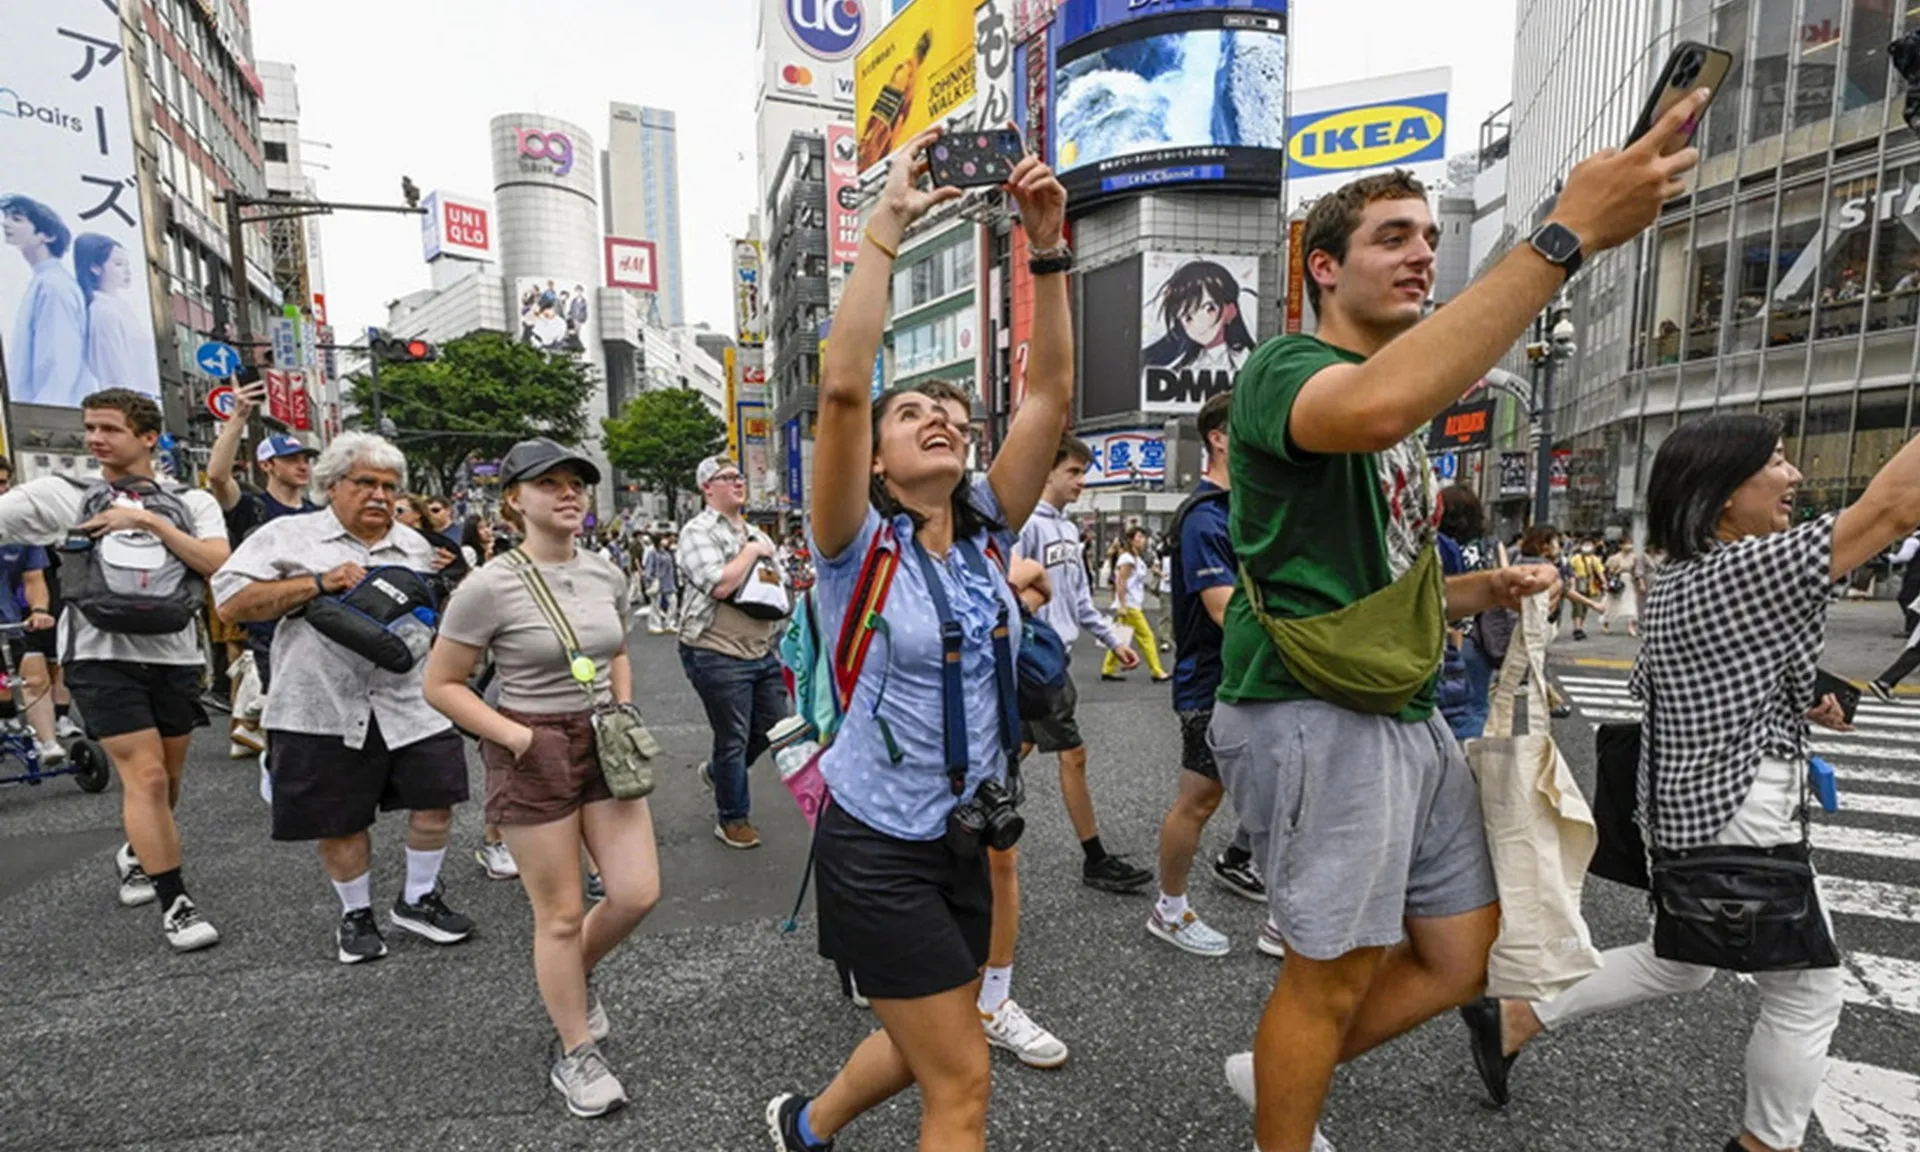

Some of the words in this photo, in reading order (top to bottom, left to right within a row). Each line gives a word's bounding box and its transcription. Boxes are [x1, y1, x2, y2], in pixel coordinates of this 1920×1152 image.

[57, 0, 138, 227] アーズ
[927, 77, 975, 118] WALKE
[16, 100, 83, 133] pairs
[511, 126, 573, 176] 109
[1300, 116, 1431, 157] IKEA
[448, 209, 481, 228] UNI
[450, 223, 485, 245] QLO
[618, 254, 645, 274] H&M
